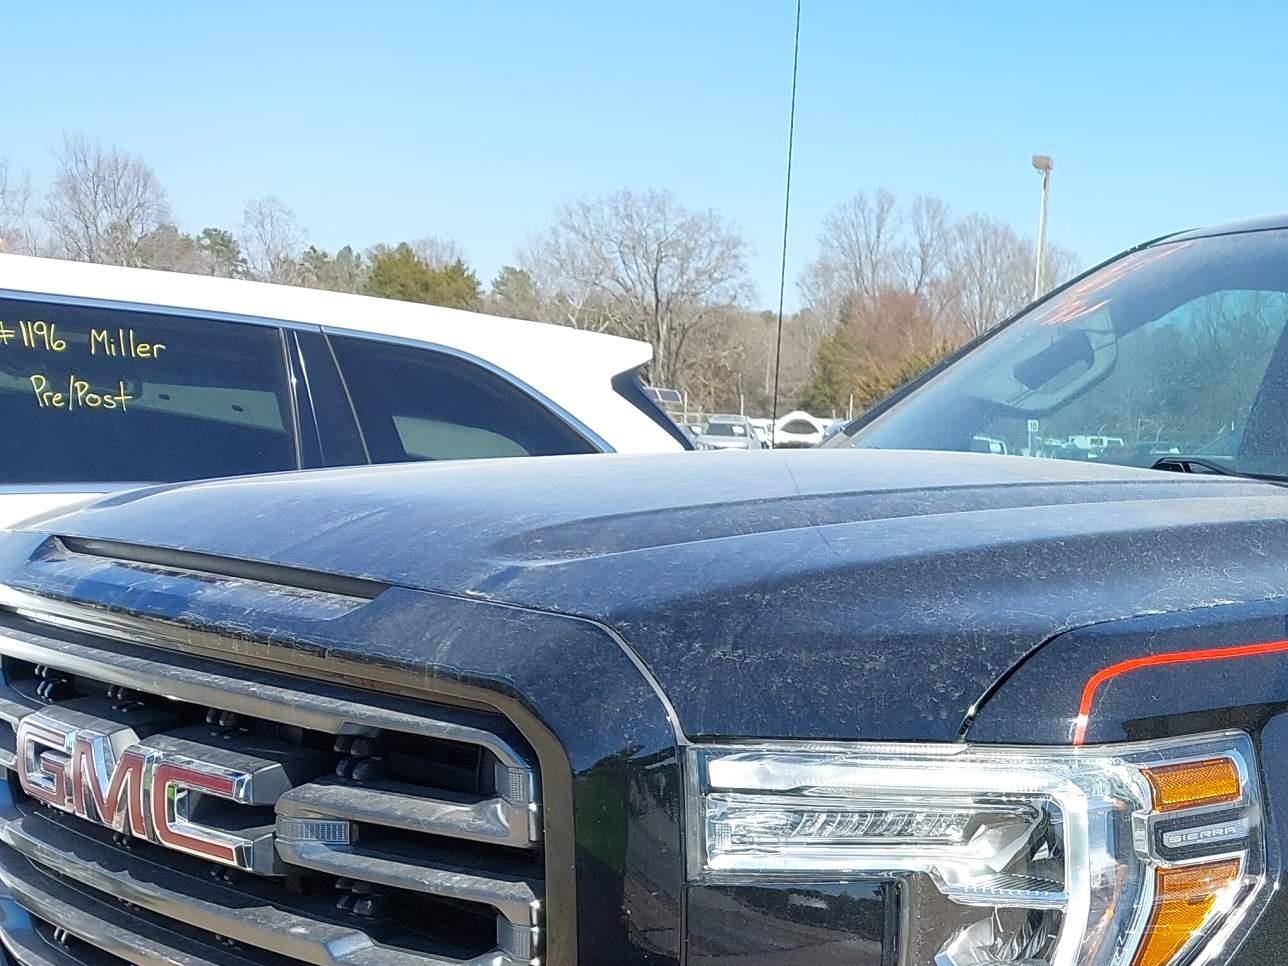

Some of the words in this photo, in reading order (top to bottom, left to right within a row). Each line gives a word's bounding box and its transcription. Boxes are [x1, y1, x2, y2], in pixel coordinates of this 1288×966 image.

[90, 328, 167, 359] Miller
[30, 374, 134, 412] Pre/Post
[17, 712, 256, 872] GMC
[1167, 826, 1237, 844] SIERRA
